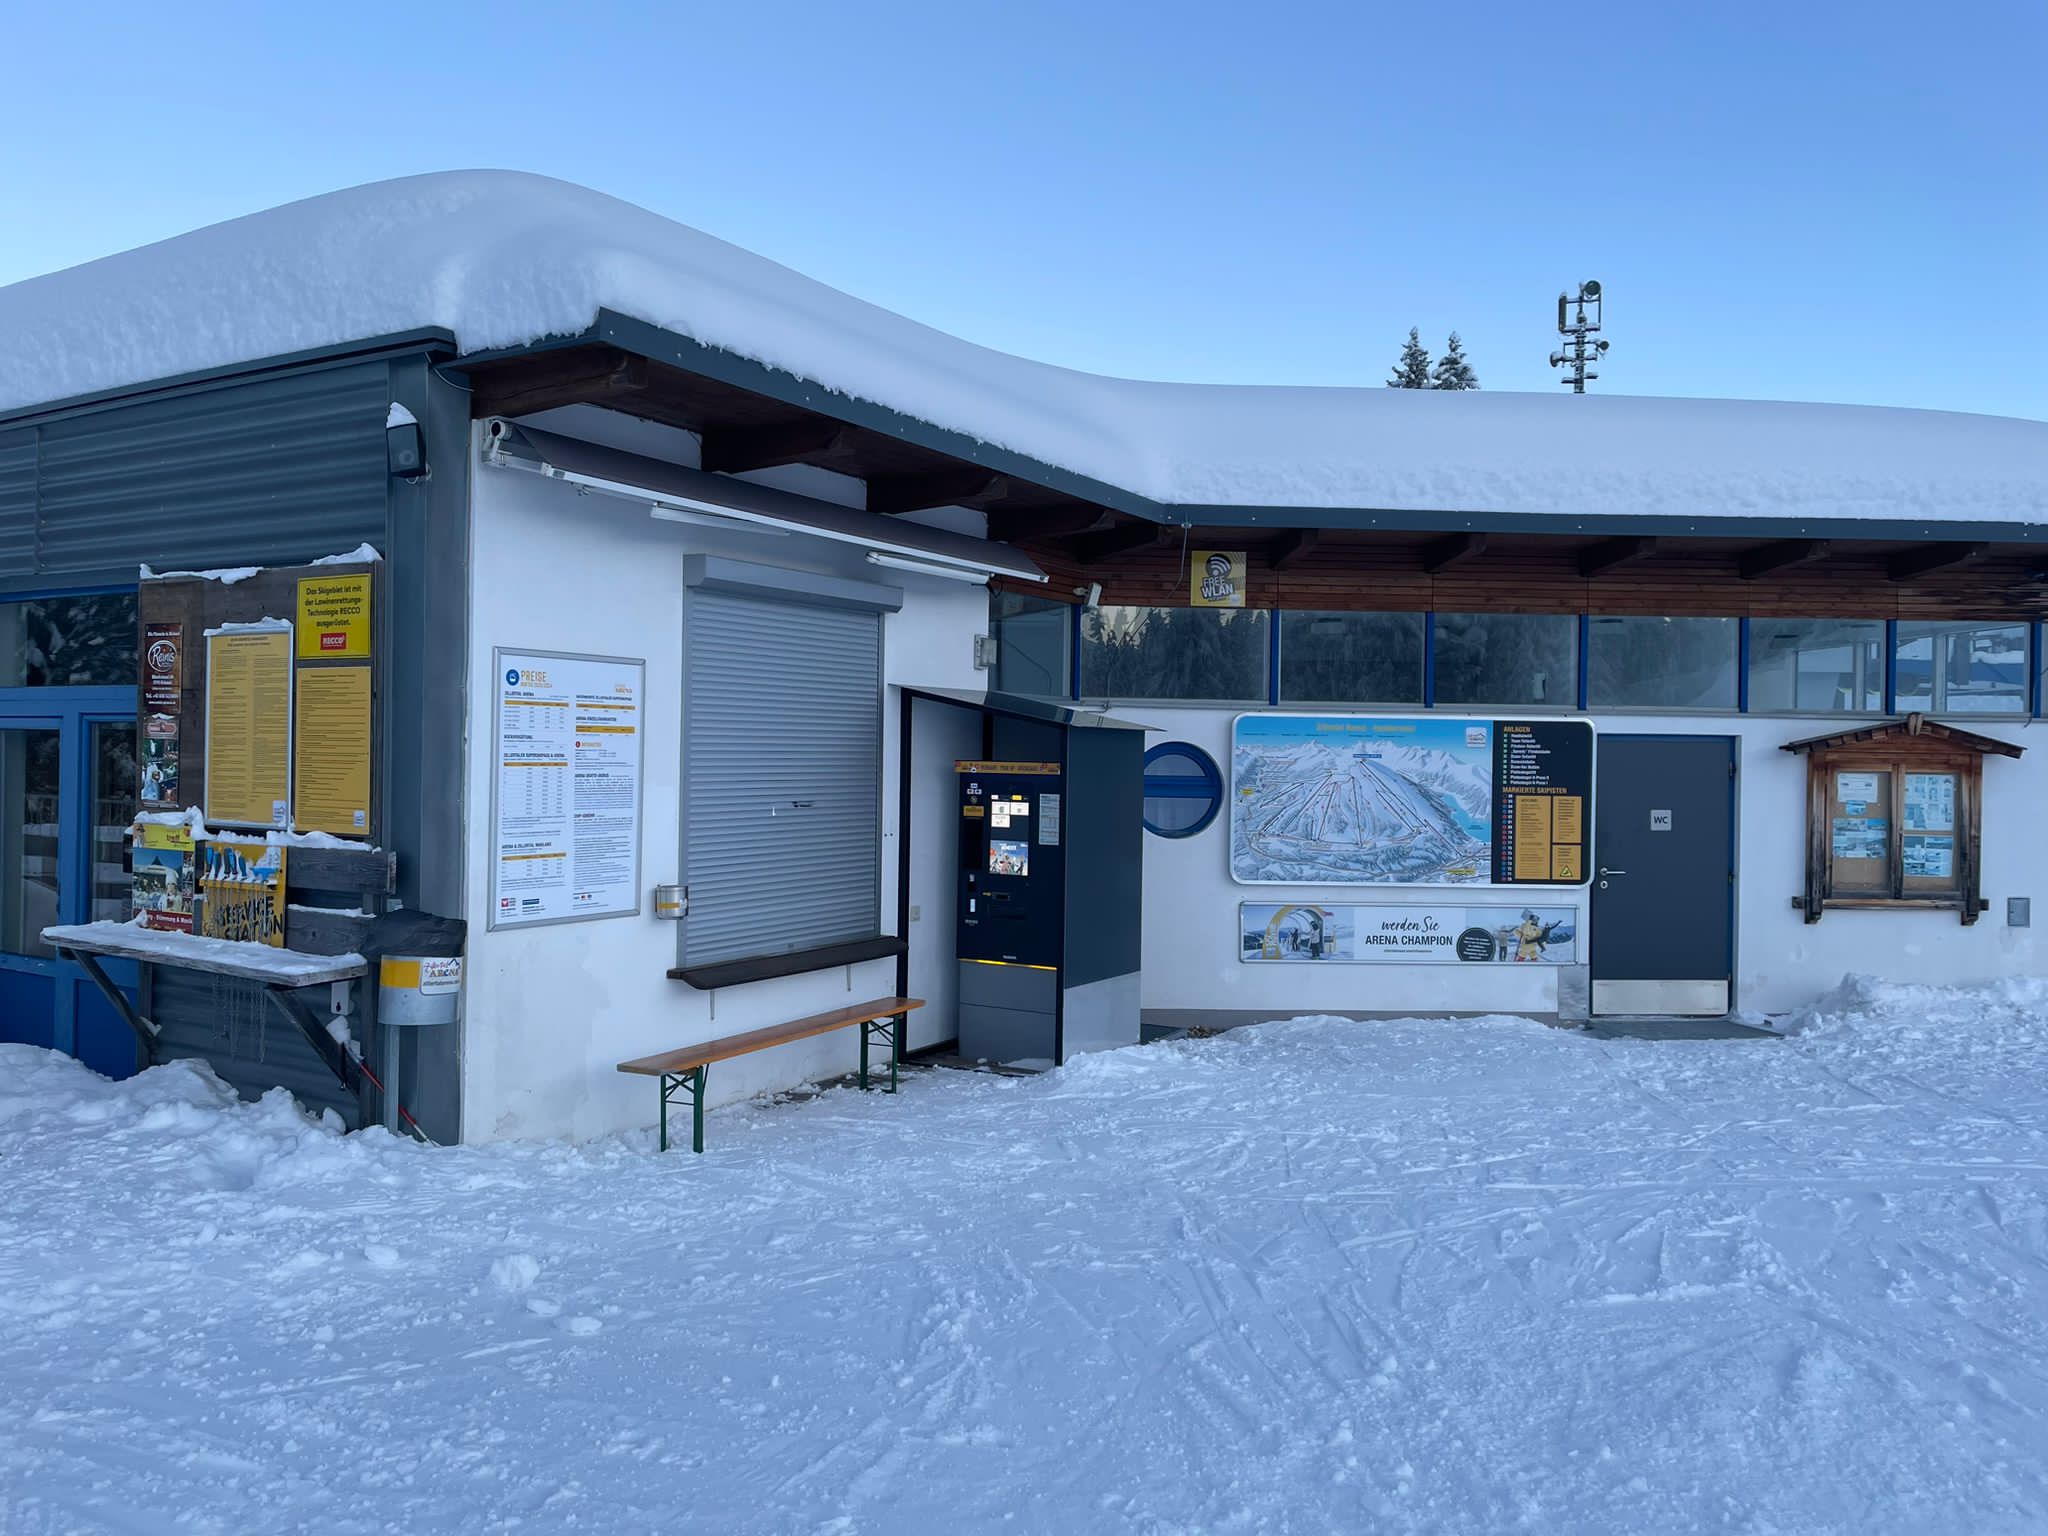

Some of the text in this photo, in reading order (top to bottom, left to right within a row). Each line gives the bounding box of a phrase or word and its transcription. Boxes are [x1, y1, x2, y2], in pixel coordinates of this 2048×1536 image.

[1203, 575, 1225, 588] FREE
[306, 587, 318, 596] Das
[319, 585, 343, 596] Skigebiet
[1201, 583, 1234, 599] WLAN
[340, 606, 361, 615] RECCO
[521, 670, 547, 682] PREISE
[1653, 815, 1668, 825] WC
[1381, 915, 1440, 933] werden Sie
[1365, 935, 1453, 945] ARENA CHAMPION
